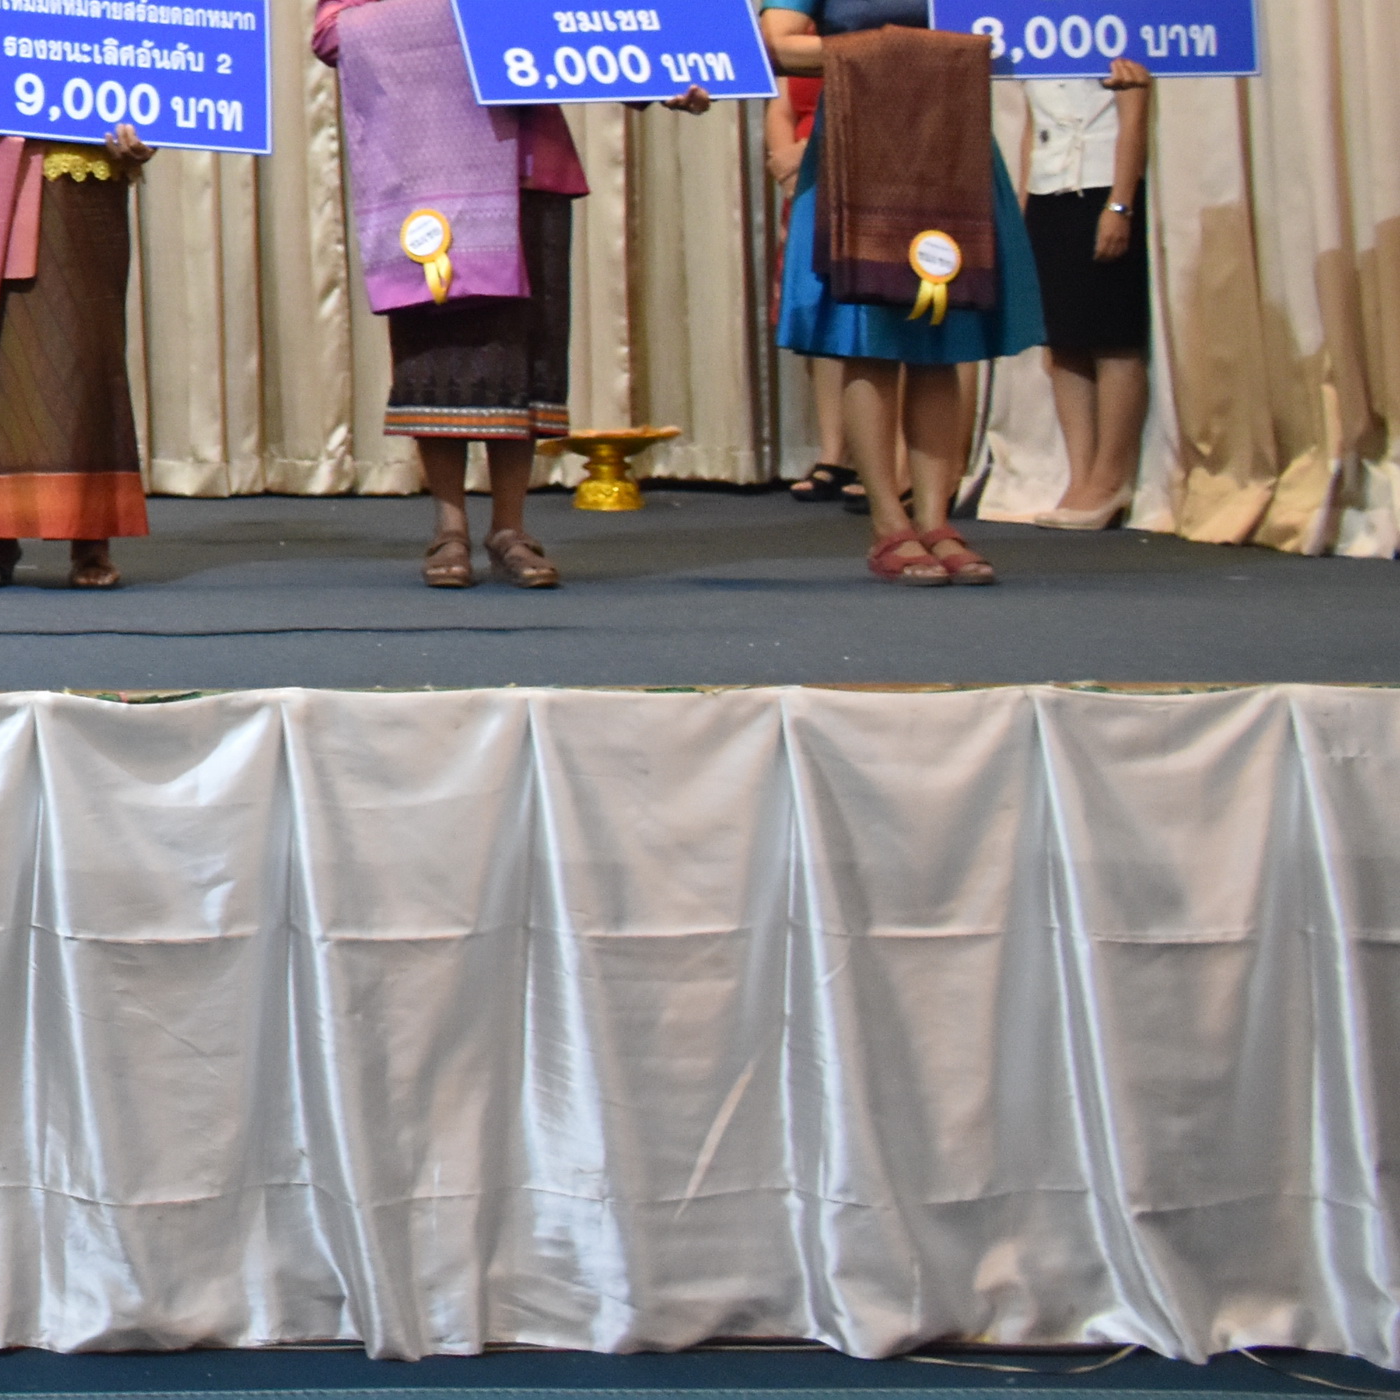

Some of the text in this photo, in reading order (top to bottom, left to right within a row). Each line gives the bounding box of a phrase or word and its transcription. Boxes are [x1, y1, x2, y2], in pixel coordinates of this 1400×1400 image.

[553, 9, 661, 33] ชมเชย
[1141, 25, 1217, 56] บาท
[216, 53, 233, 74] 2
[504, 44, 735, 89] 8,000 บาท
[14, 72, 243, 132] 9,000 บาท
